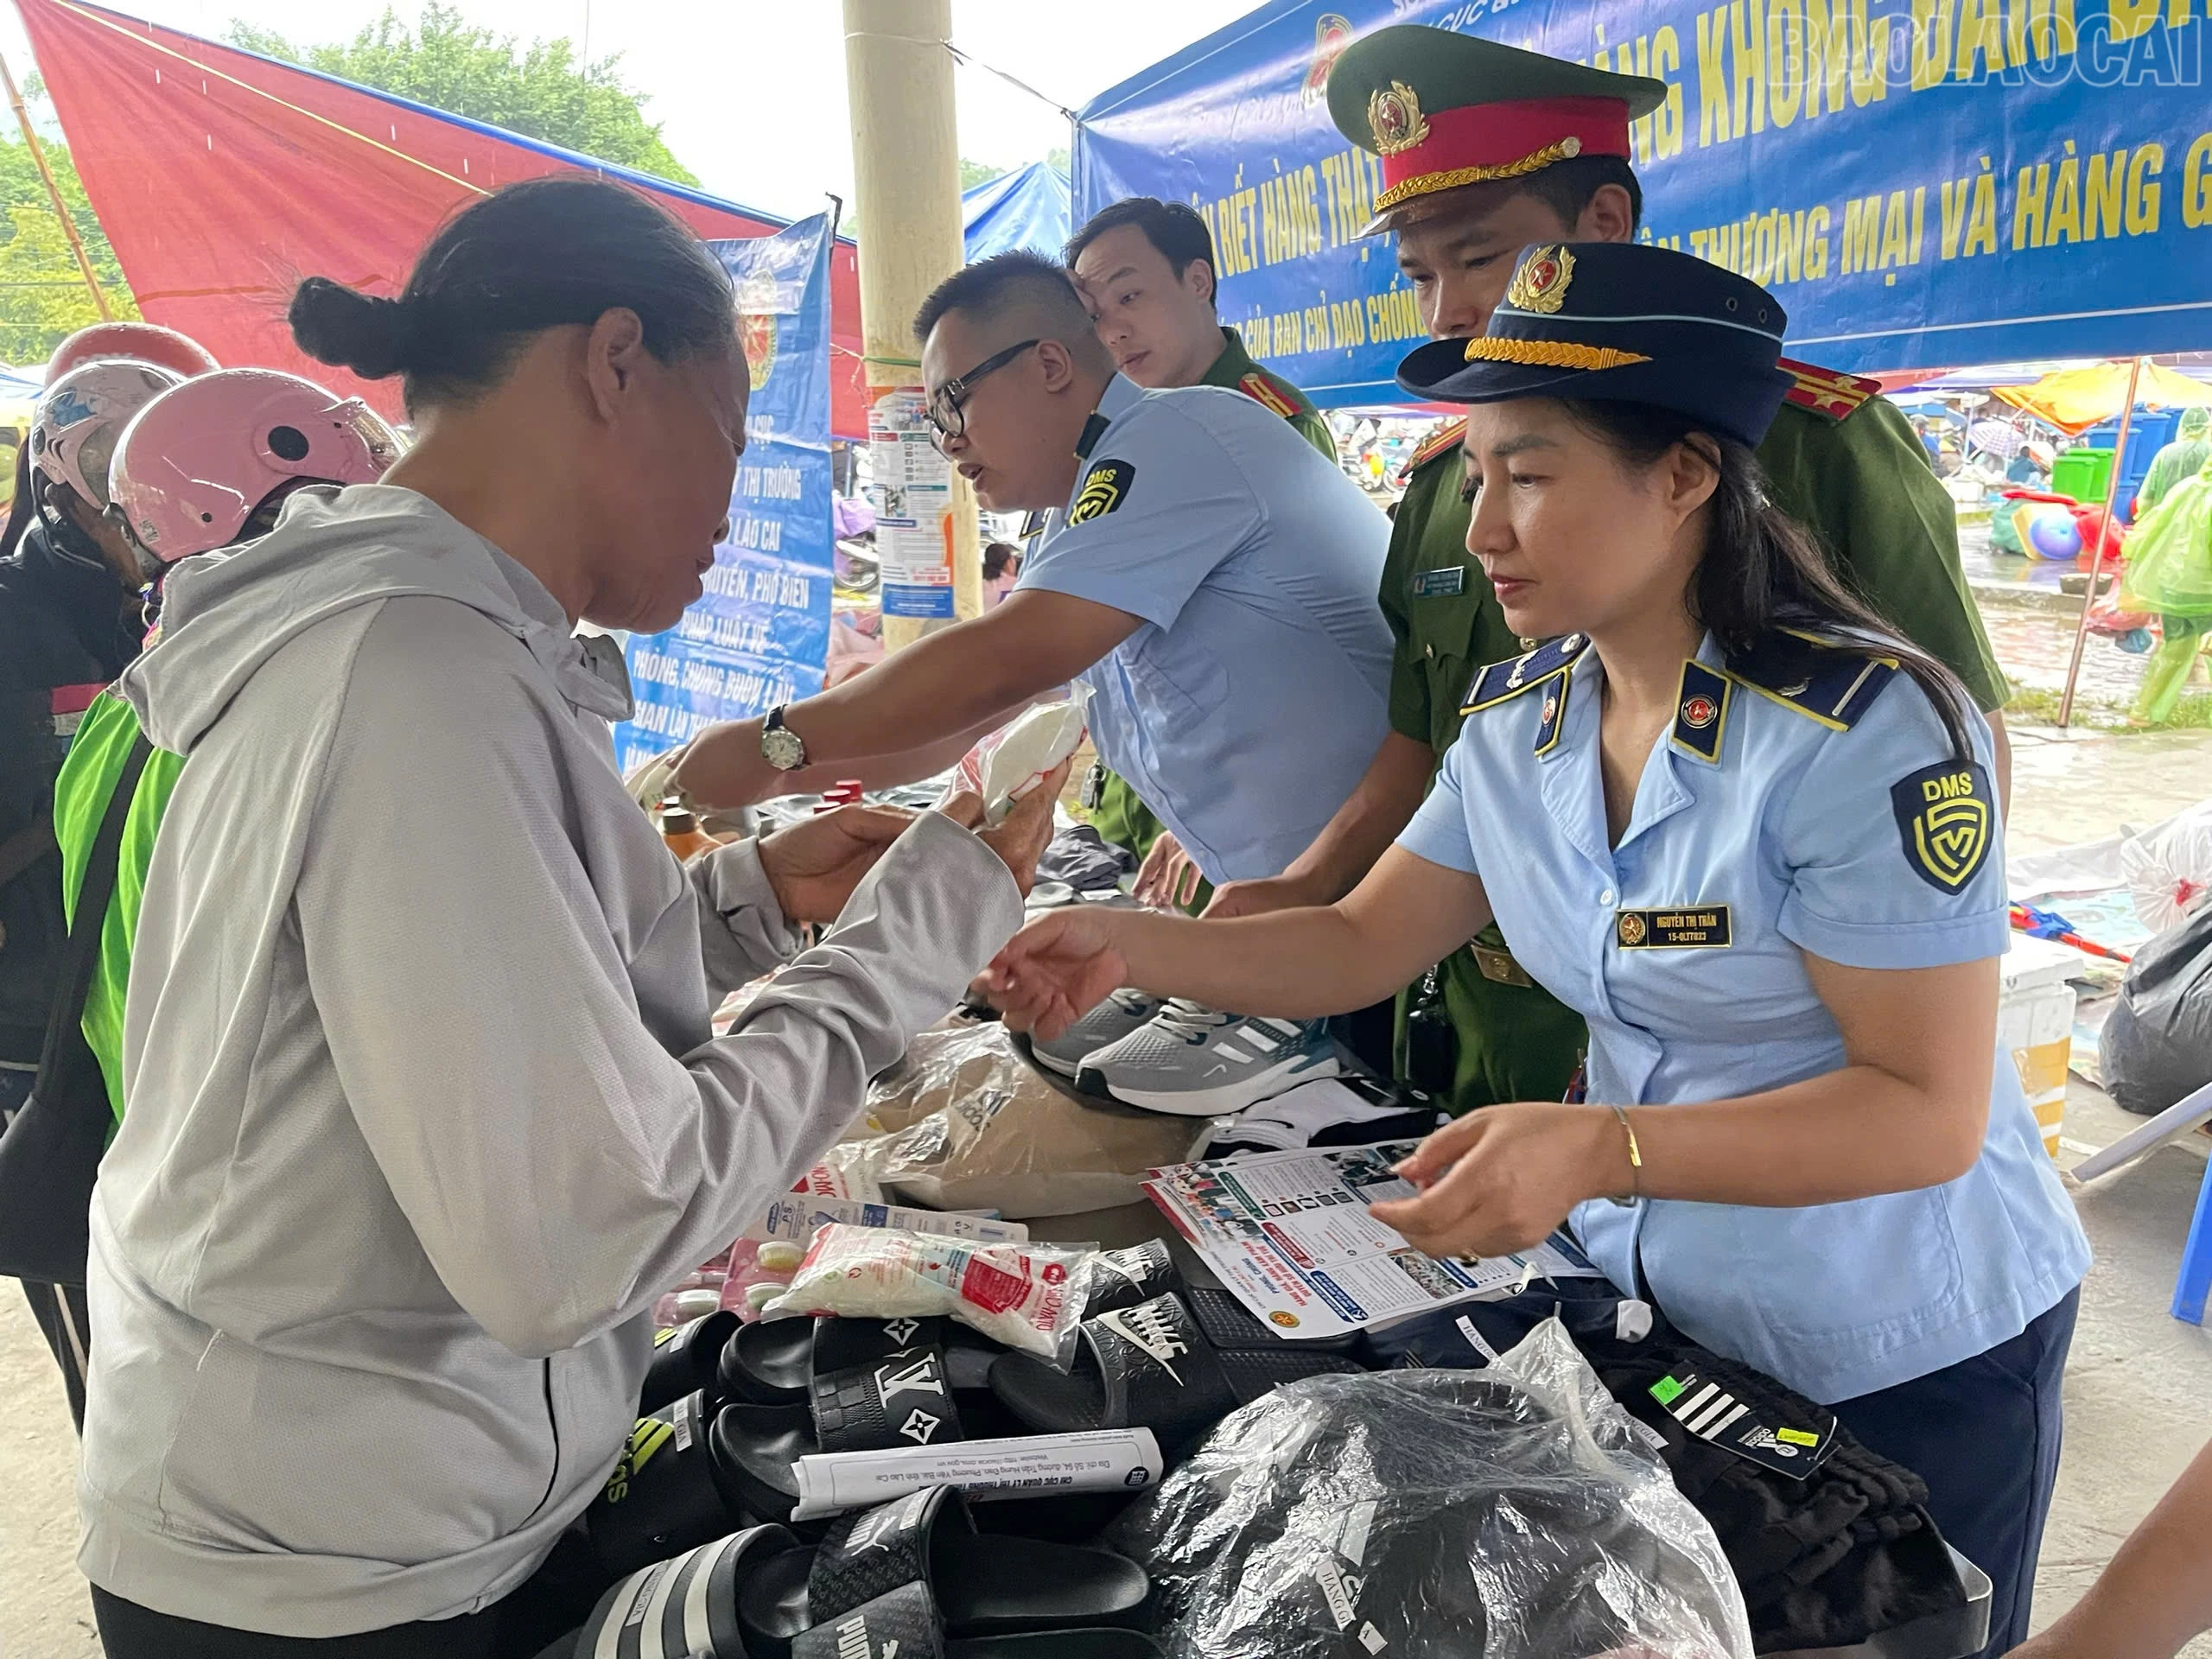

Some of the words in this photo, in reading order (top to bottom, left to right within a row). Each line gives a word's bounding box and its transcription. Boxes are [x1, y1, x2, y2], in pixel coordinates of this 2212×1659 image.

[1260, 158, 1321, 265] HÀNG
[1840, 186, 1926, 287] MẠI
[1941, 156, 1997, 261] VÀ
[2012, 139, 2164, 251] HÀNG
[1274, 311, 1301, 357] BAN
[1305, 289, 1331, 353] CHỈ
[1085, 468, 1117, 486] DMS
[760, 520, 781, 551] CAI
[1923, 772, 1973, 801] DMS
